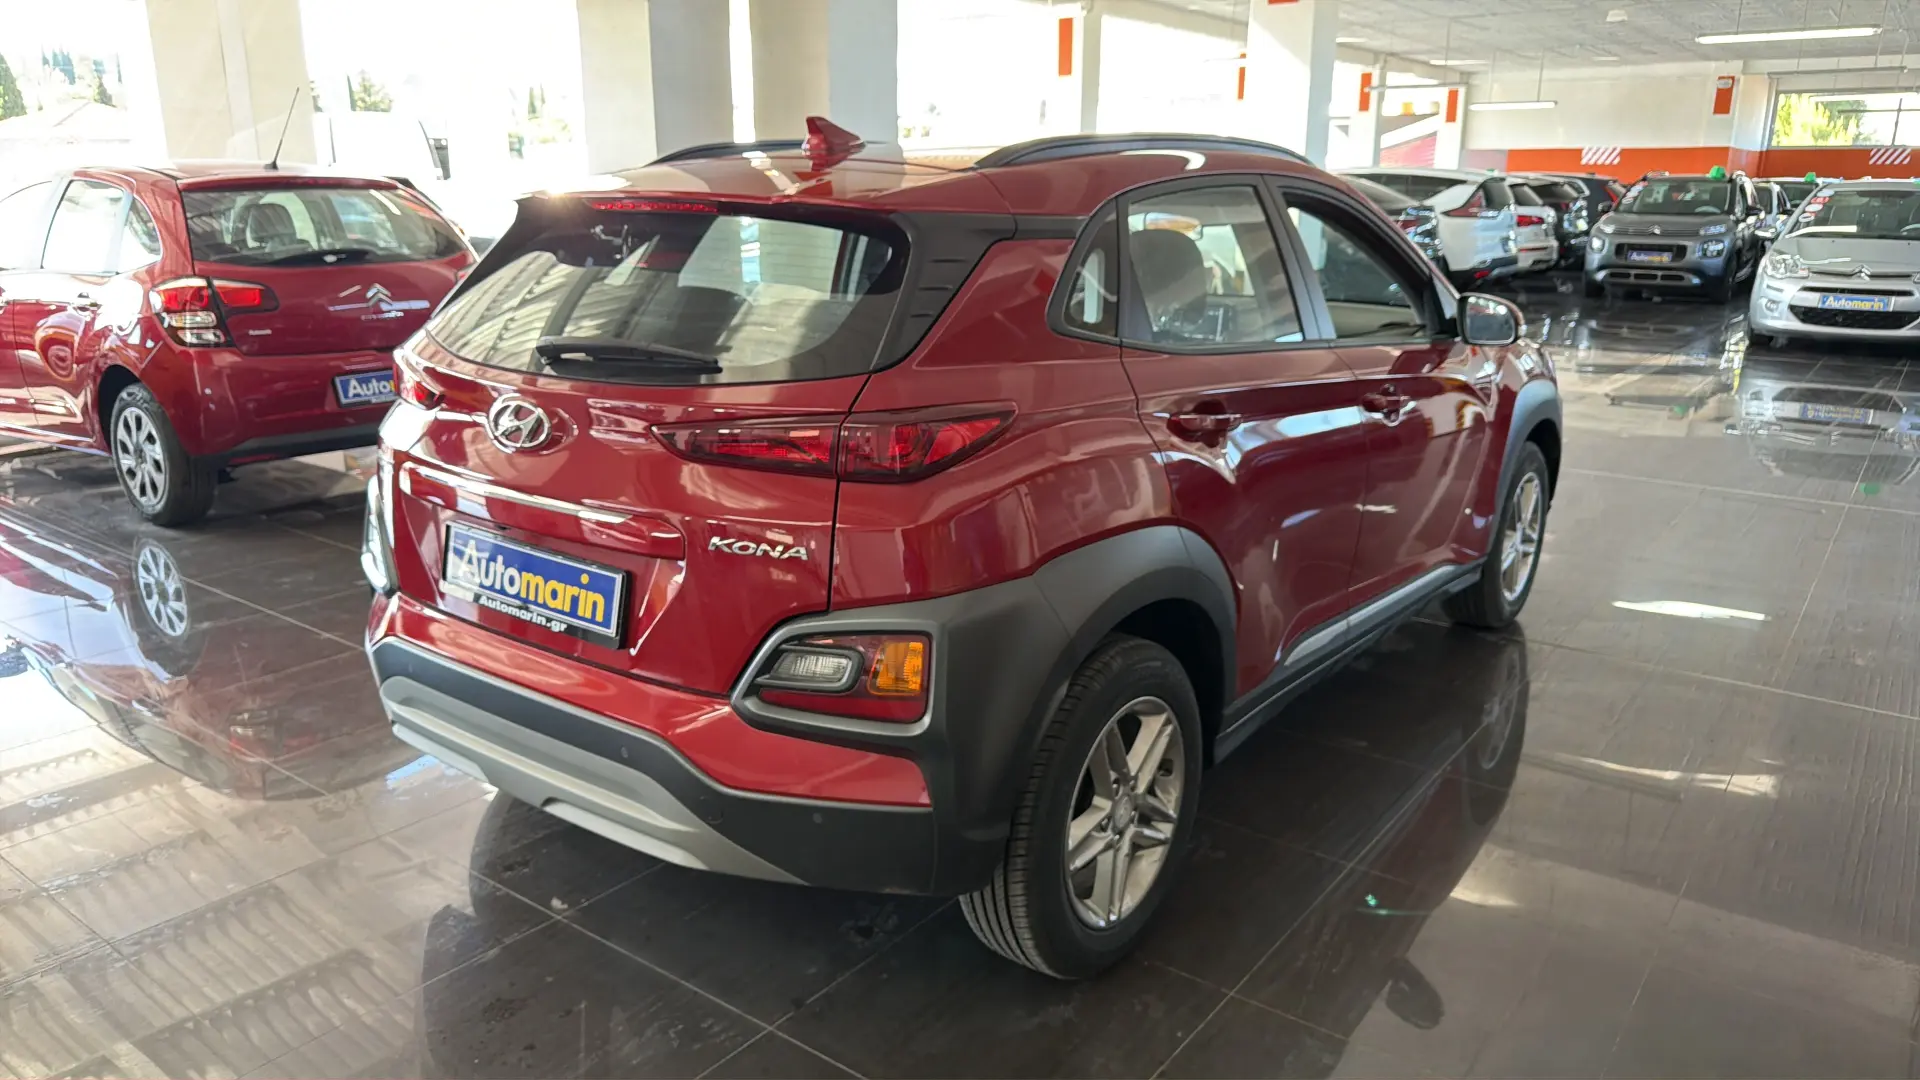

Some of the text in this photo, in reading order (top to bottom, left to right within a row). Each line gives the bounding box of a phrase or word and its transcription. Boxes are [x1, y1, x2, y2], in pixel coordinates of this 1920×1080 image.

[1826, 296, 1884, 310] Automarin
[708, 537, 808, 560] KONA
[459, 540, 604, 622] Automarin
[478, 595, 567, 632] Automarin.gr
